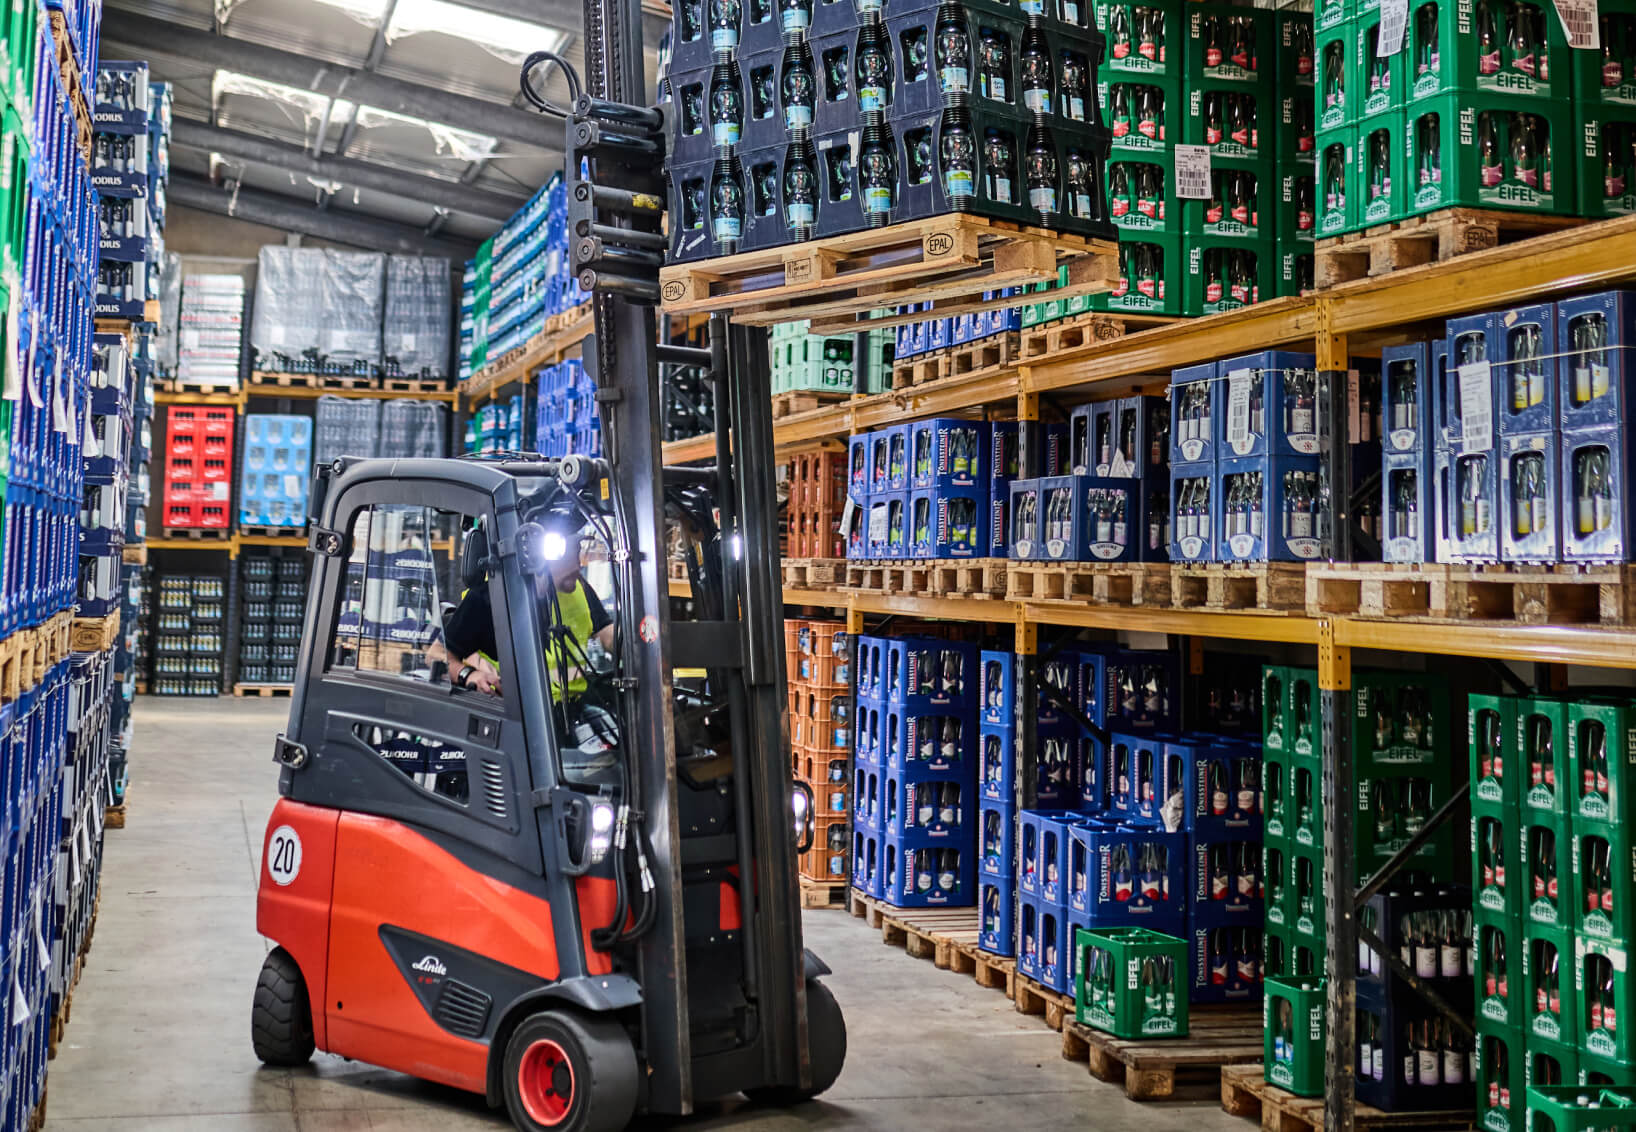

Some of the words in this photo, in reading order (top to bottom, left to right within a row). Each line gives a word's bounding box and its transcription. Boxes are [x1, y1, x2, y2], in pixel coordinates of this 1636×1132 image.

[1098, 4, 1108, 30] EIFEL
[1191, 13, 1200, 38] EIFEL
[1283, 22, 1292, 46] EIFEL
[1124, 58, 1152, 70] EIFEL
[1218, 65, 1245, 78] EIFEL
[1496, 75, 1534, 90] EIFEL
[1190, 90, 1201, 116] EIFEL
[94, 112, 123, 122] ODIUS
[1283, 98, 1293, 123] EIFEL
[1460, 108, 1473, 144] EIFEL
[1124, 136, 1152, 148] EIFEL
[1584, 120, 1597, 156] EIFEL
[1218, 143, 1246, 154] EIFEL
[92, 176, 122, 186] ODIUS
[1283, 176, 1293, 202] EIFEL
[1500, 186, 1537, 200] EIFEL
[1124, 213, 1152, 227] EIFEL
[1217, 220, 1245, 233] EIFEL
[99, 239, 120, 249] DIUS
[930, 238, 949, 251] EPAL
[1190, 247, 1201, 274] EIFEL
[1284, 253, 1293, 280] EIFEL
[1122, 294, 1152, 307] EIFEL
[1358, 686, 1368, 718] EIFEL
[1568, 720, 1576, 758] EIFEL
[1390, 748, 1415, 760] EIFEL
[1359, 778, 1370, 810] EIFEL
[1482, 785, 1498, 797] EIFEL
[1532, 792, 1551, 805] EIFEL
[1584, 800, 1604, 813] EIFEL
[273, 836, 294, 874] 20
[1484, 894, 1501, 906] EIFEL
[1536, 906, 1554, 919] EIFEL
[1588, 919, 1608, 932] EIFEL
[412, 956, 446, 976] Linde
[1128, 957, 1138, 990] EIFEL
[1486, 1003, 1504, 1016] EIFEL
[1148, 1020, 1172, 1031] EIFEL
[1310, 1004, 1320, 1040] EIFEL
[1538, 1020, 1556, 1034] EIFEL
[1592, 1037, 1612, 1050] EIFEL
[1488, 1114, 1507, 1129] EIFEL
